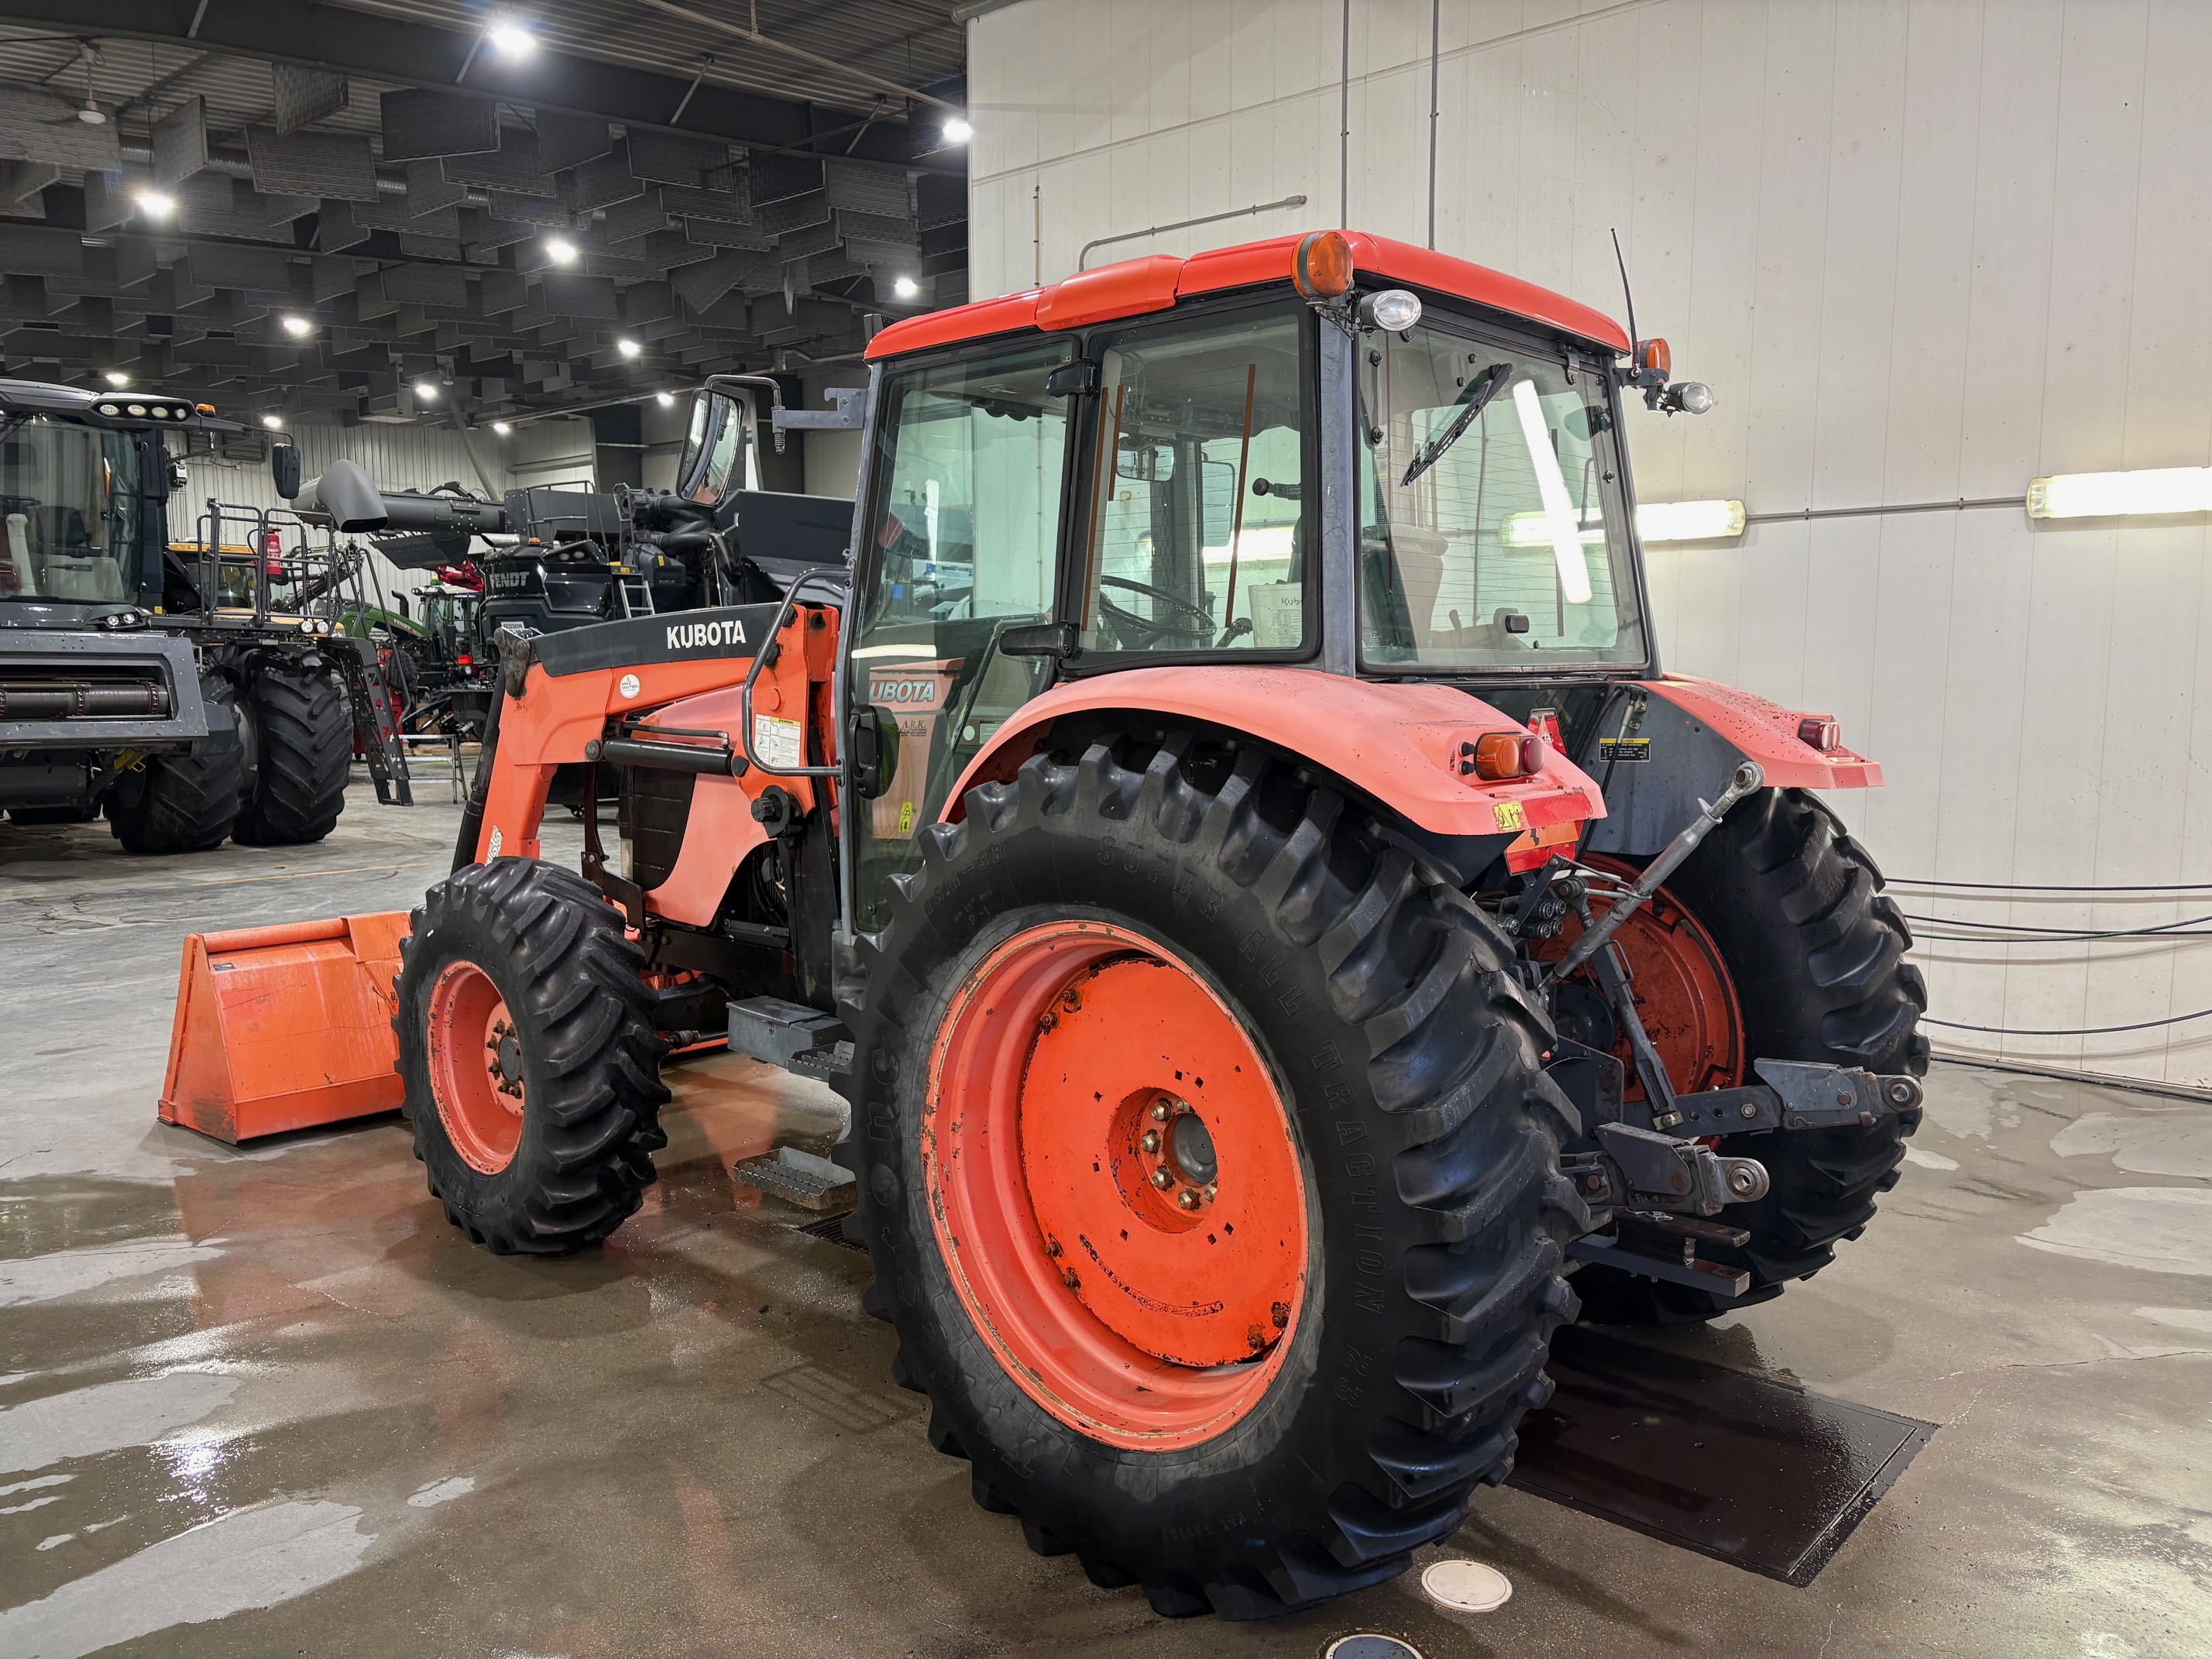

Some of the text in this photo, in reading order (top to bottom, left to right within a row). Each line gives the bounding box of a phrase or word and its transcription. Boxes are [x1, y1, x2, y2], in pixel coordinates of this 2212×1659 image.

[489, 571, 530, 589] FENDT
[1281, 596, 1302, 606] Kub
[393, 618, 410, 630] FENDT
[666, 620, 747, 650] KUBOTA
[869, 679, 935, 702] UBOTA
[902, 720, 926, 729] A.R.K.
[924, 843, 1004, 916] 18.4-38
[1097, 836, 1387, 1409] SUPER ALL TRACTION 23
